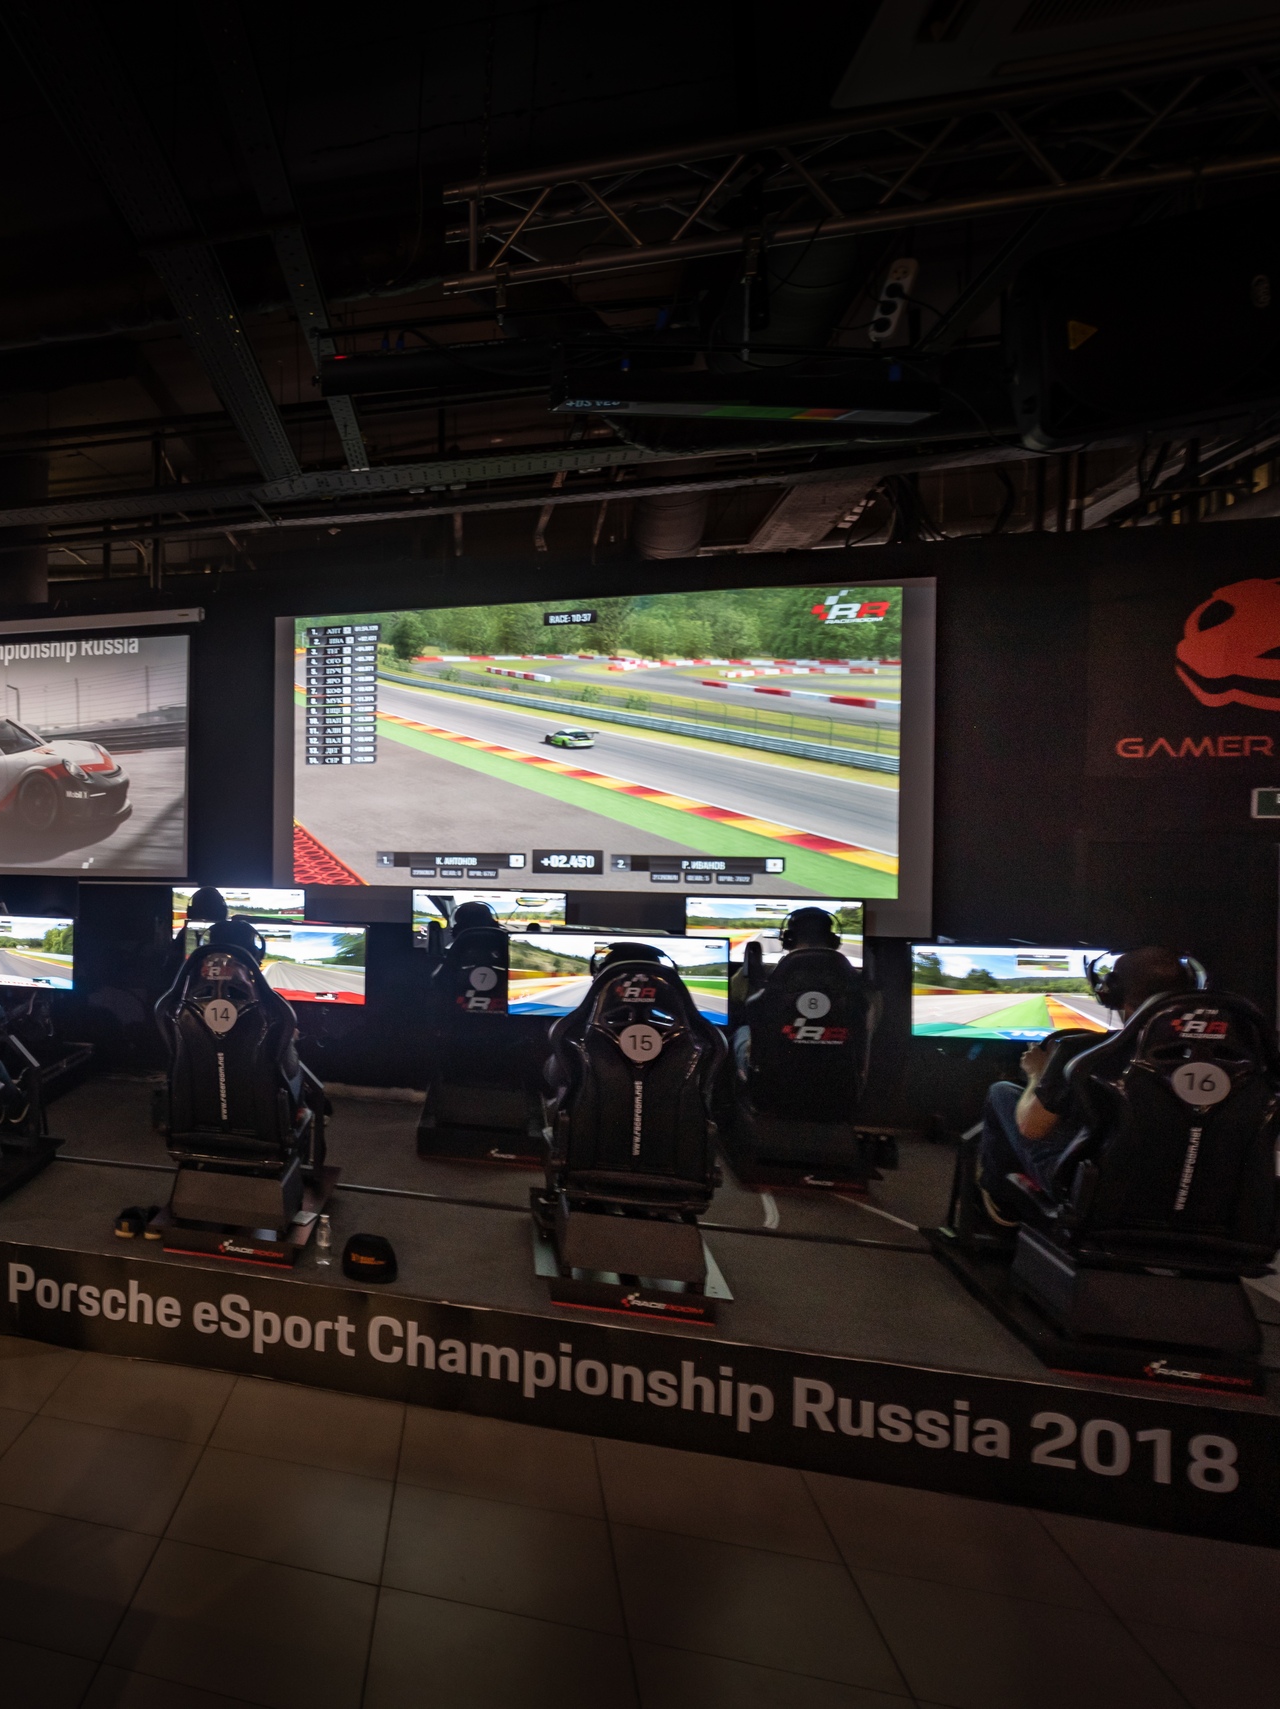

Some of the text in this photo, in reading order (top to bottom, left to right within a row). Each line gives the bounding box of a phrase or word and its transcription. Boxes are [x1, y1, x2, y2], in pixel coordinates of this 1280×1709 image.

[548, 614, 571, 624] RACE:
[824, 616, 884, 625] RACEROOM
[1115, 735, 1275, 759] GAMER
[541, 855, 595, 869] +02.450
[479, 972, 488, 984] 7
[808, 997, 819, 1010] 8
[210, 1007, 230, 1022] 14
[628, 1034, 654, 1051] 15
[216, 1052, 229, 1121] www.raceroom.net
[1183, 1072, 1217, 1092] 16
[631, 1080, 644, 1157] www.raceroom.net
[1173, 1126, 1204, 1212] www.raceroom.net
[226, 1245, 285, 1260] RACEROOM
[629, 1299, 705, 1316] RACEROOM
[7, 1262, 1241, 1494] Porsche eSport Championship Russia 2018
[1154, 1367, 1255, 1387] RACEROOM
